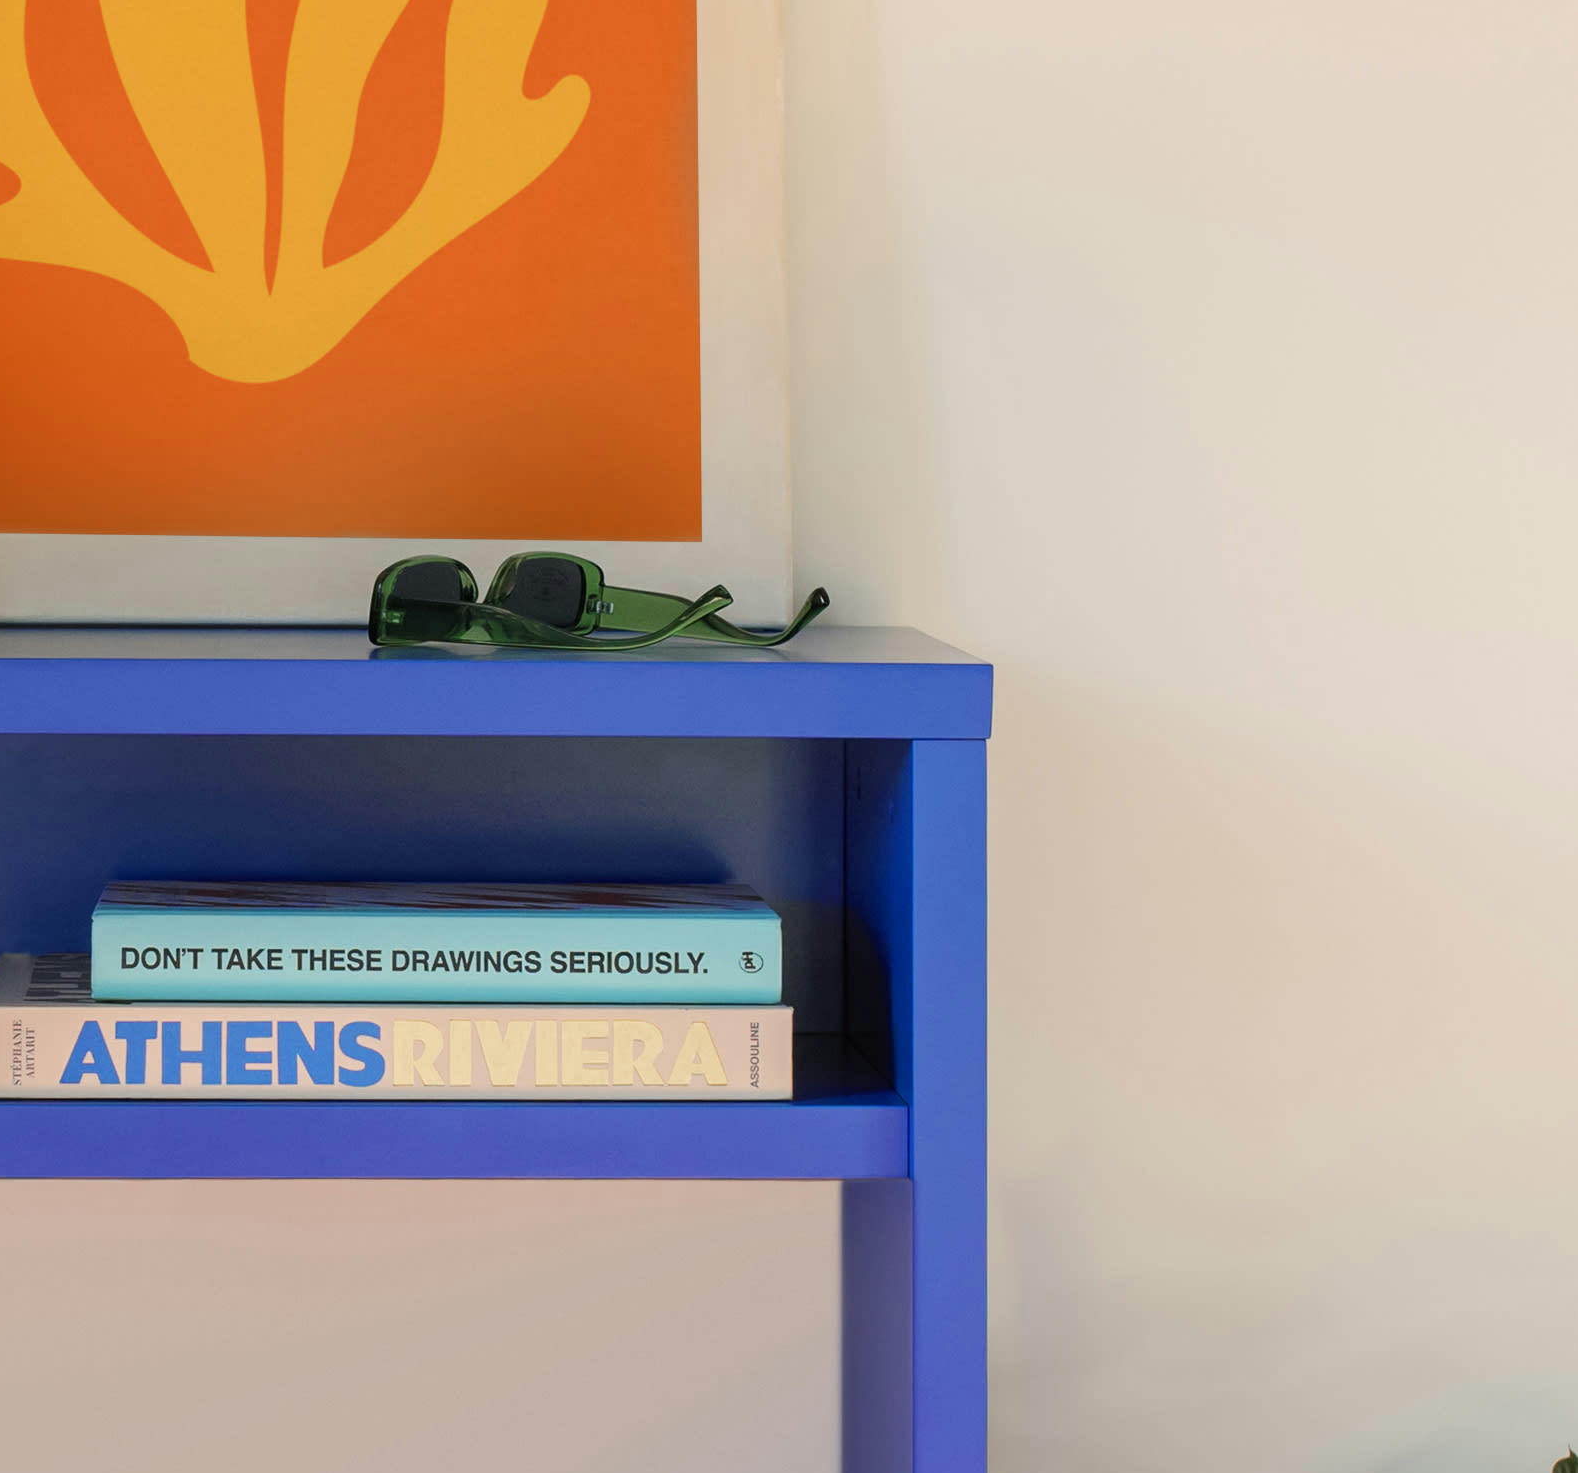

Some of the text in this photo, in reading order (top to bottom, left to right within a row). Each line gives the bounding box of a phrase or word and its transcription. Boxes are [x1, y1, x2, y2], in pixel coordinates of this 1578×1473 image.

[121, 946, 709, 974] DON'T TAKE THESE DRAWINGS SERIOUSLY.
[10, 1019, 22, 1086] STÉPHANIE
[25, 1027, 36, 1078] ARTARIT
[749, 1022, 760, 1088] ASSOULINE
